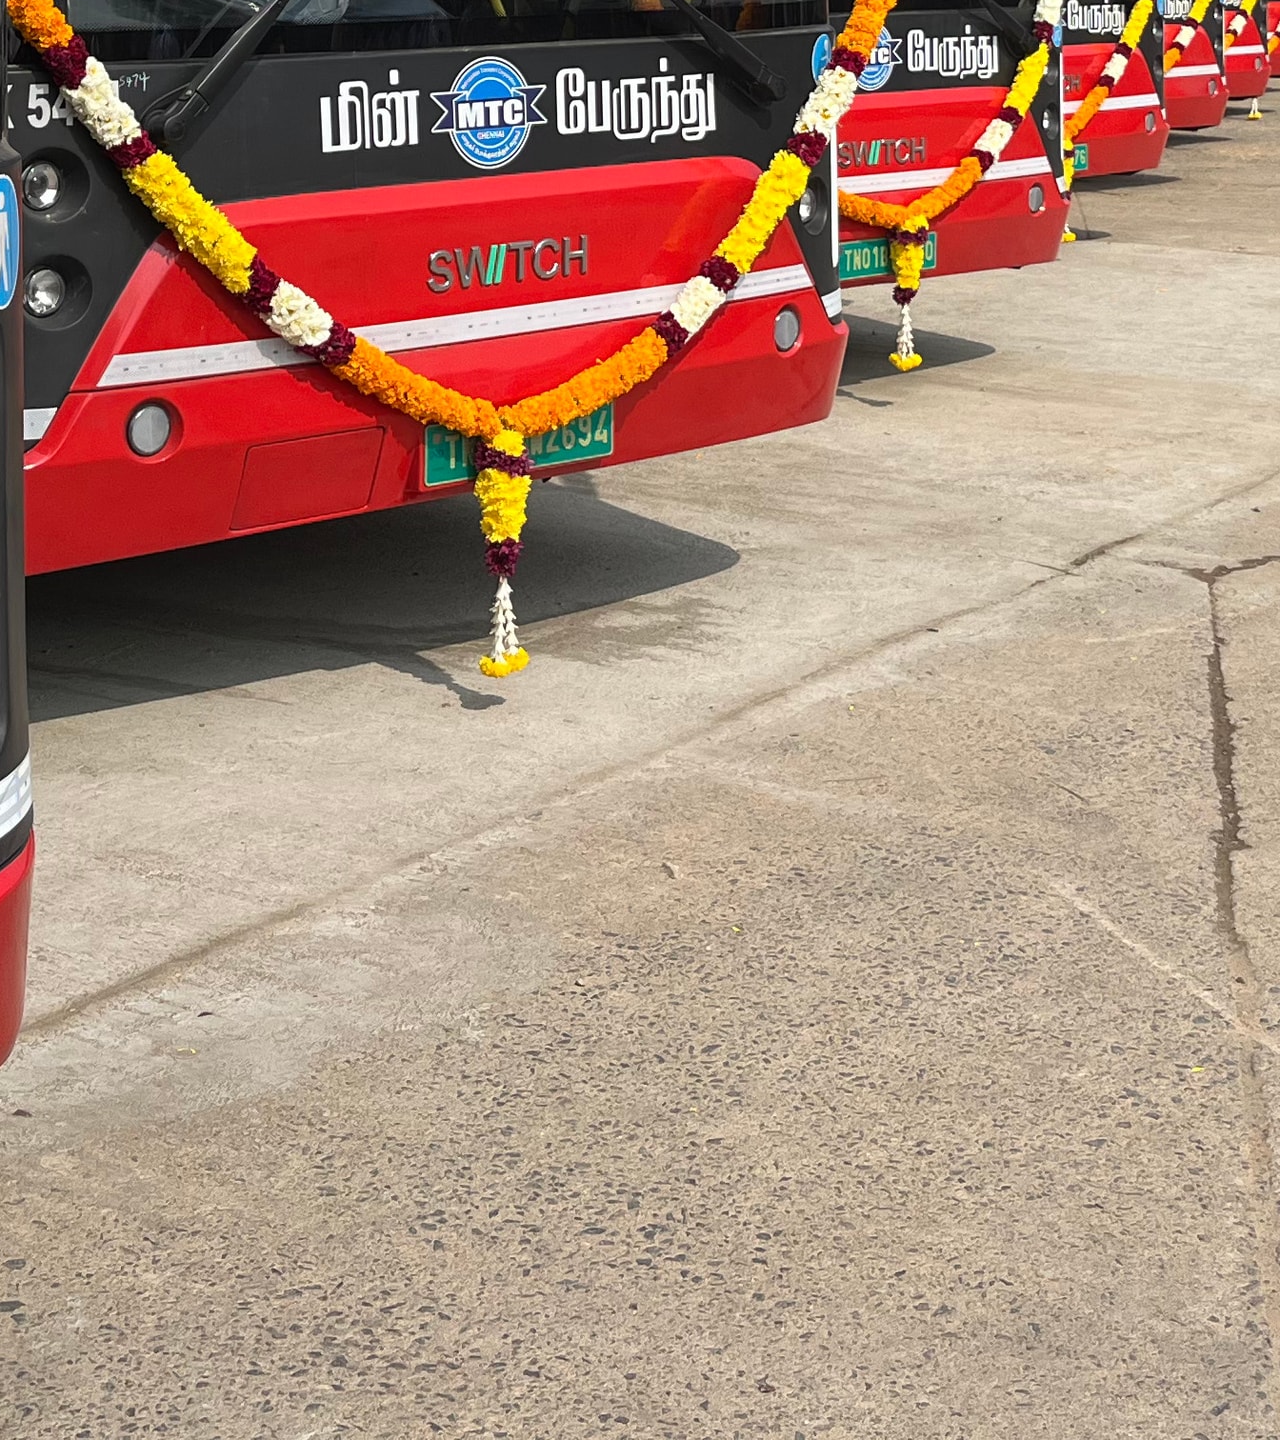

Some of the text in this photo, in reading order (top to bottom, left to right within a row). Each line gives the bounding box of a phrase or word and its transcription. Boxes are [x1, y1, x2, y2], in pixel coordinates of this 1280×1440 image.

[907, 25, 1000, 79] பேருந்து
[320, 69, 421, 153] மின்
[457, 98, 524, 130] MTC
[555, 58, 717, 143] பேருந்து
[837, 137, 926, 168] SWITCH
[426, 234, 589, 293] SWITCH
